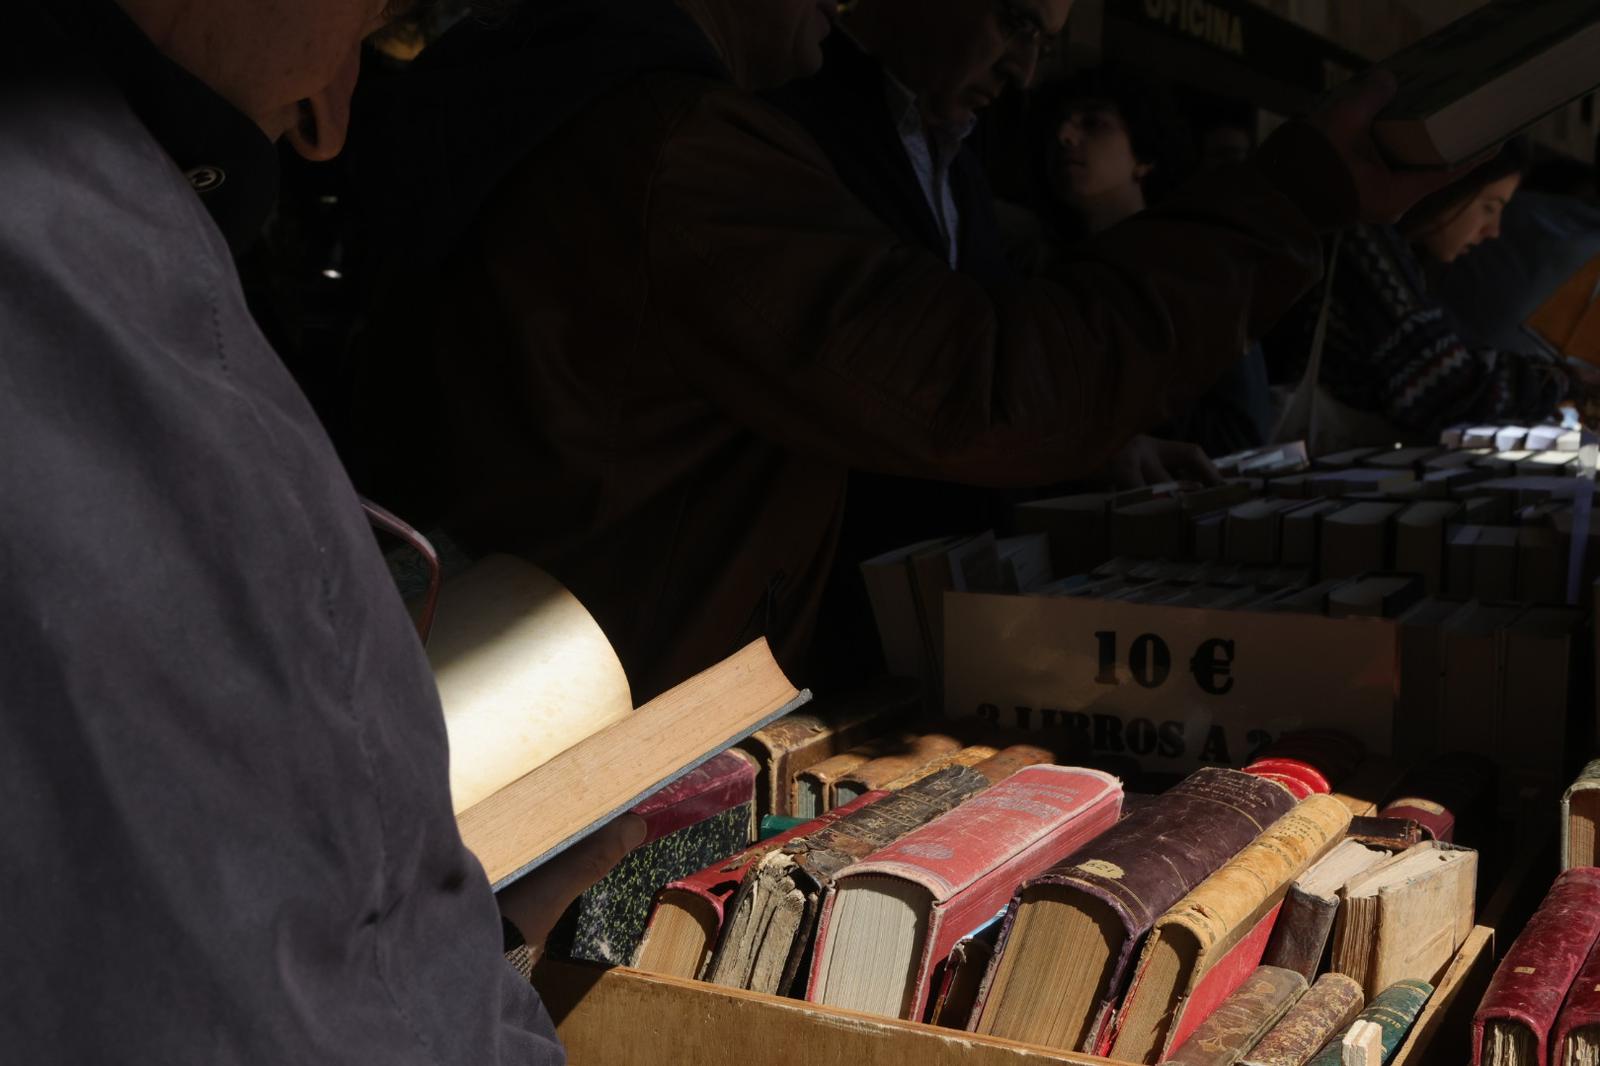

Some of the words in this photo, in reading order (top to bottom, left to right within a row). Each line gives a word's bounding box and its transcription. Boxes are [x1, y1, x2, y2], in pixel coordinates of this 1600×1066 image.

[1094, 630, 1171, 689] 10
[1190, 637, 1235, 695] €
[1198, 724, 1232, 764] A
